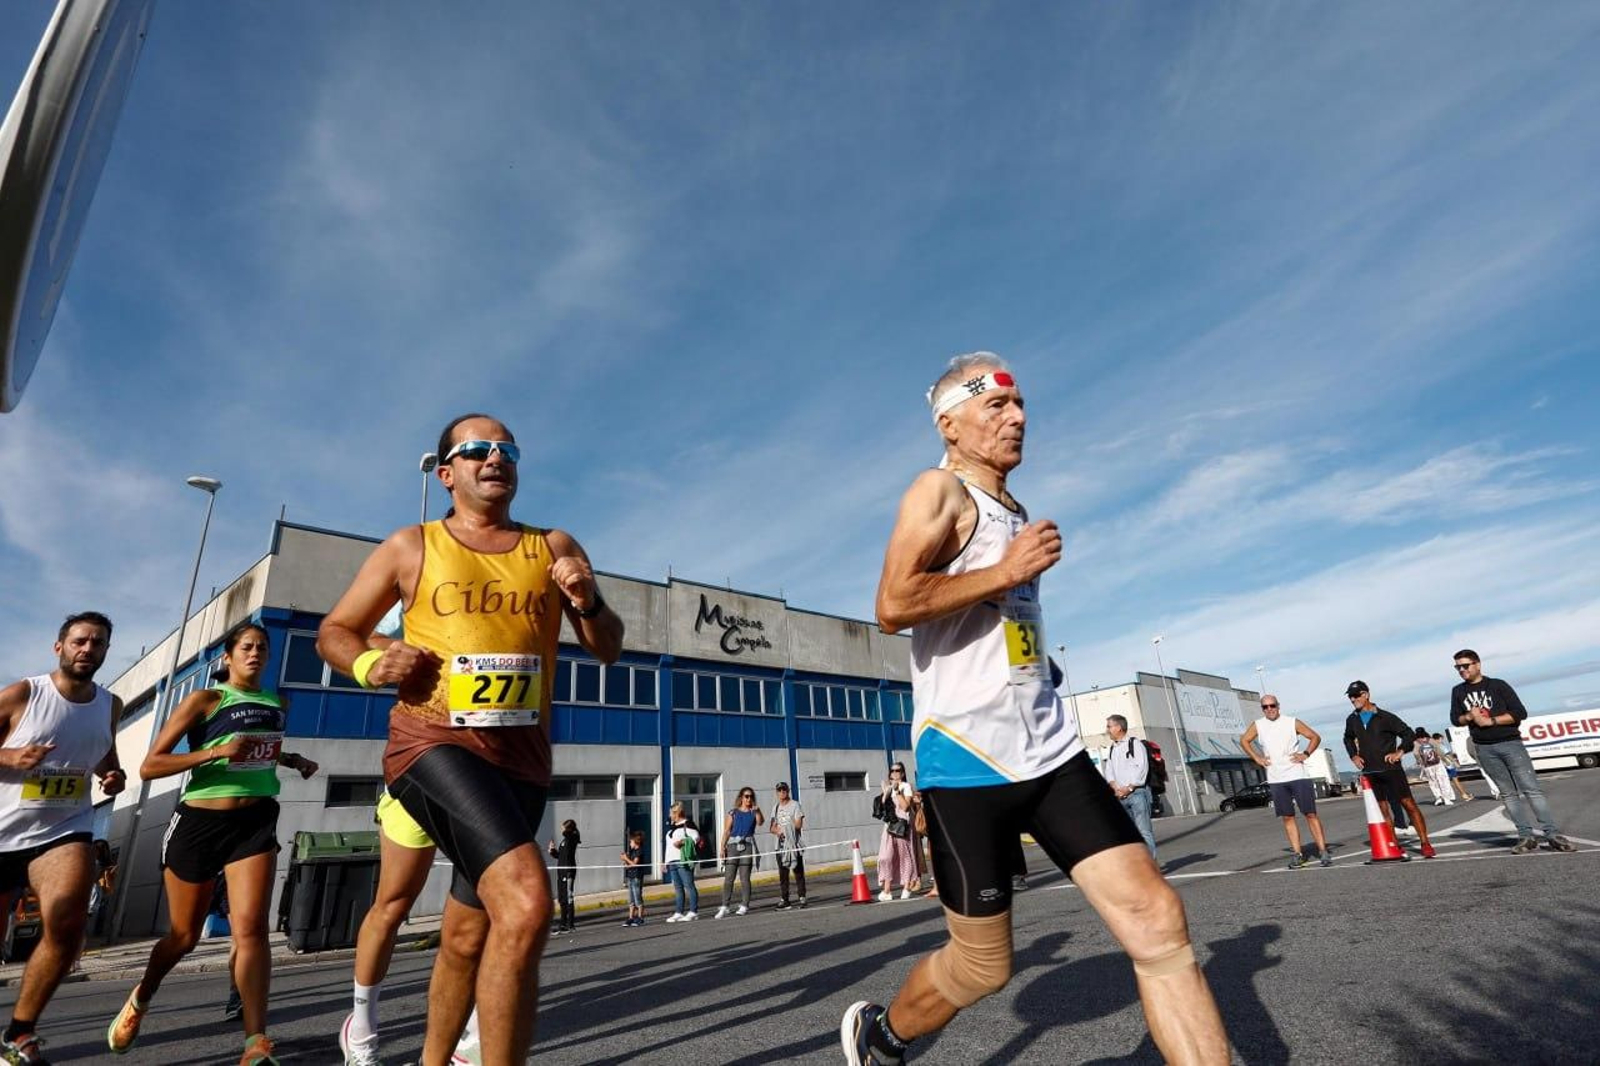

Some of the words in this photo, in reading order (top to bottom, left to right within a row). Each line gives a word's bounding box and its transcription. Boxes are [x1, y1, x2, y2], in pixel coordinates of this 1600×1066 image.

[432, 580, 551, 617] Cibus
[475, 657, 497, 666] KMS
[471, 675, 531, 704] 277
[230, 709, 246, 720] SAN
[40, 778, 76, 795] 115
